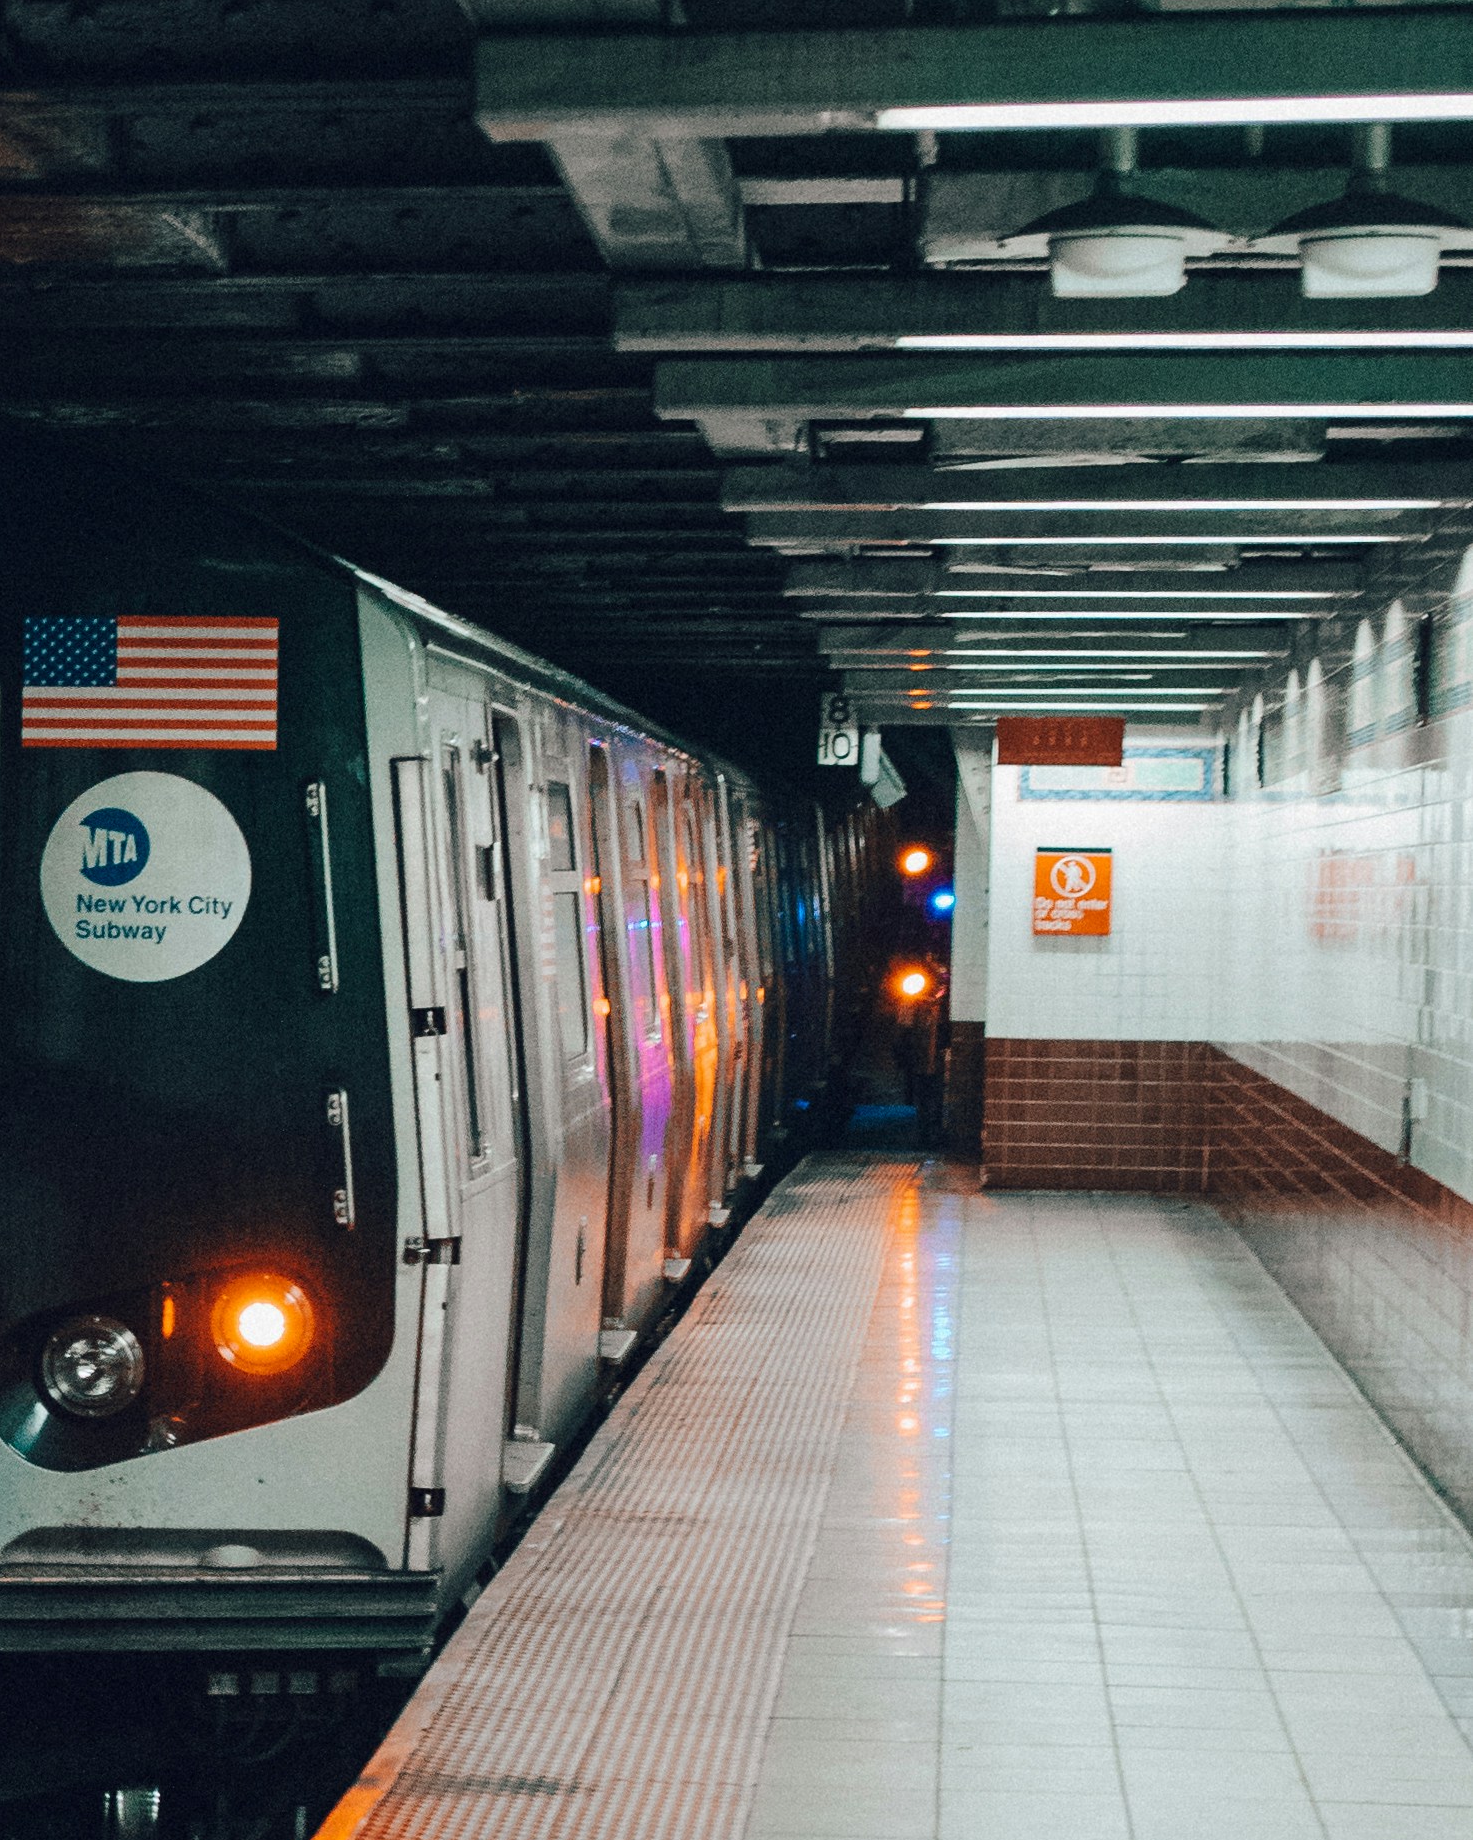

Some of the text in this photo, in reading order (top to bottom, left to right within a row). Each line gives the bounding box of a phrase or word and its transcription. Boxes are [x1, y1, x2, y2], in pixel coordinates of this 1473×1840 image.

[829, 696, 851, 725] 8
[822, 732, 851, 760] 10
[78, 823, 139, 870] MTA
[76, 894, 233, 920] New York City
[75, 919, 167, 945] Subway
